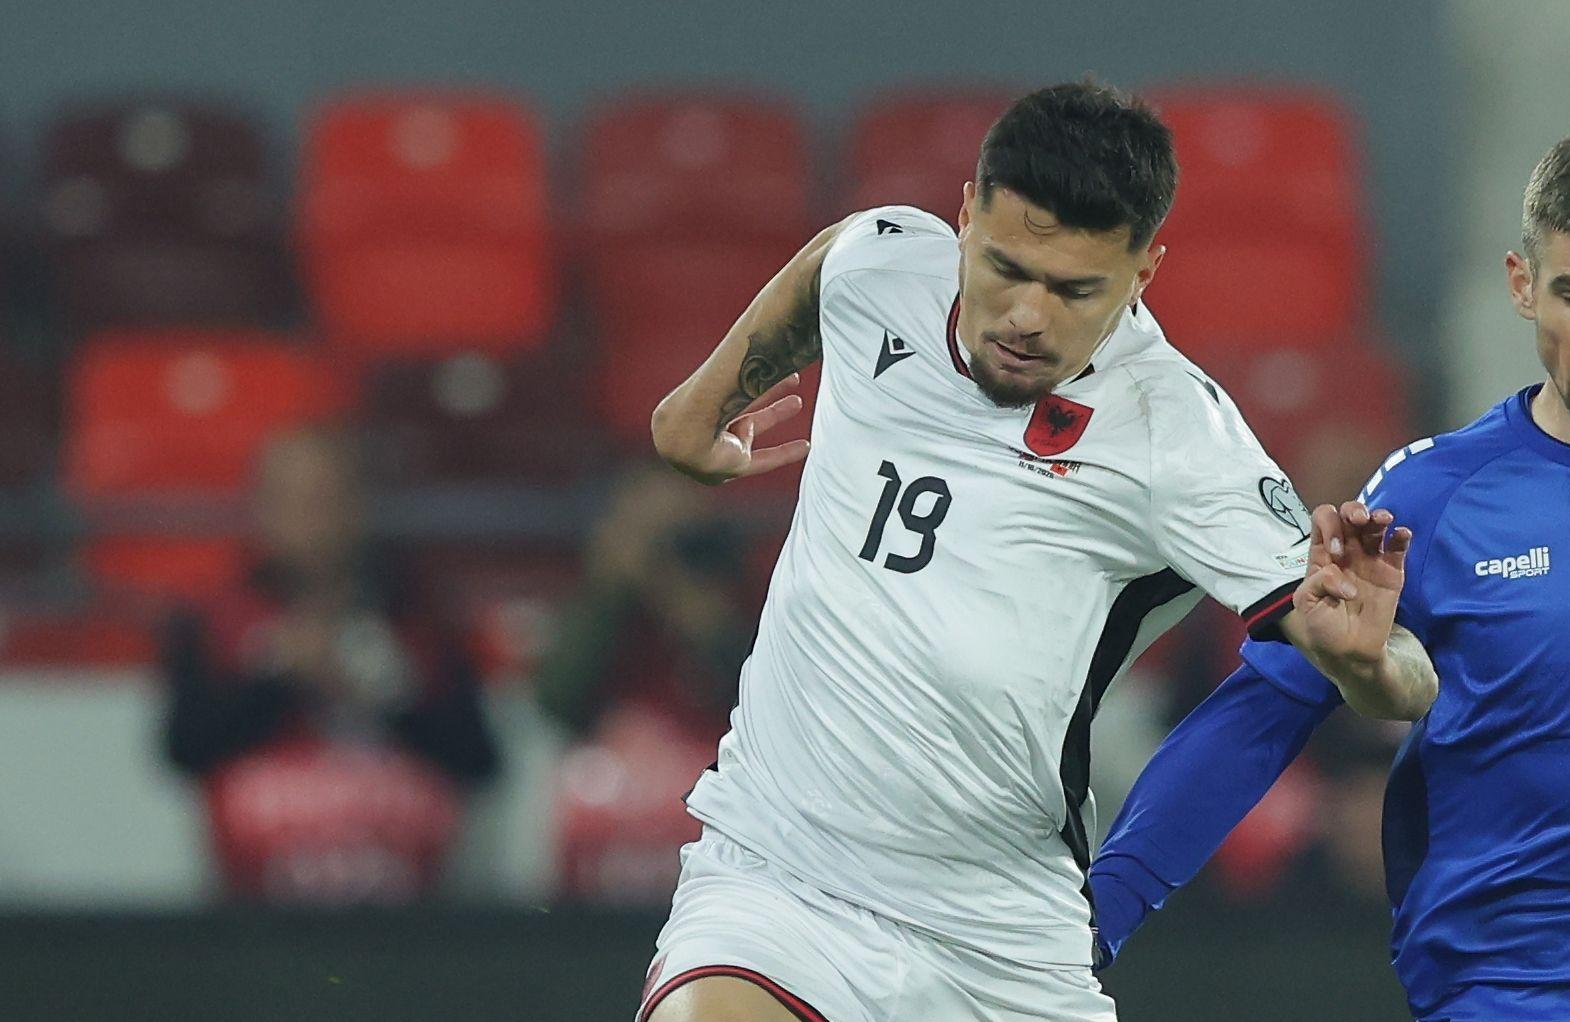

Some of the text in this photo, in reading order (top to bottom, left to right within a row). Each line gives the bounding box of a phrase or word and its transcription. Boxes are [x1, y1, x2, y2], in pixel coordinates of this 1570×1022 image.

[858, 459, 953, 574] 19
[1475, 546, 1550, 579] capelli
[1509, 566, 1551, 580] SPORT
